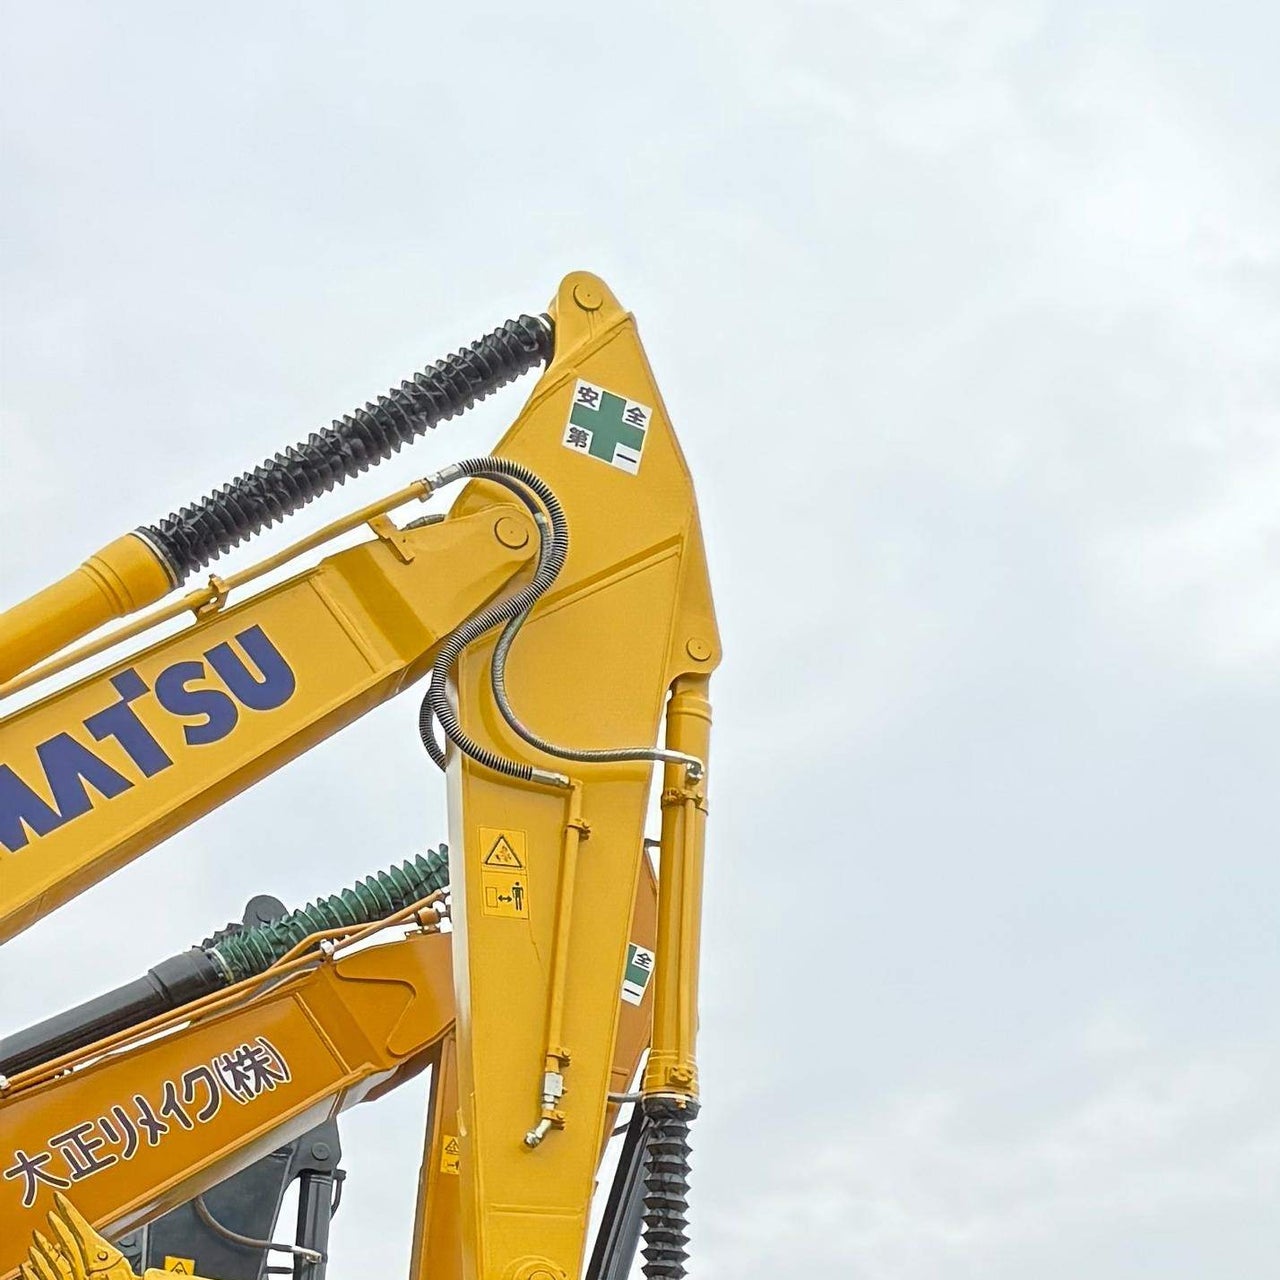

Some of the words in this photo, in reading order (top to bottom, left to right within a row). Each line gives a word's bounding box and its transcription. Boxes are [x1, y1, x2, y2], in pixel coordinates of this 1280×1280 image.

[636, 952, 653, 970] 全
[4, 1036, 292, 1207] 大正リメイク(株)
